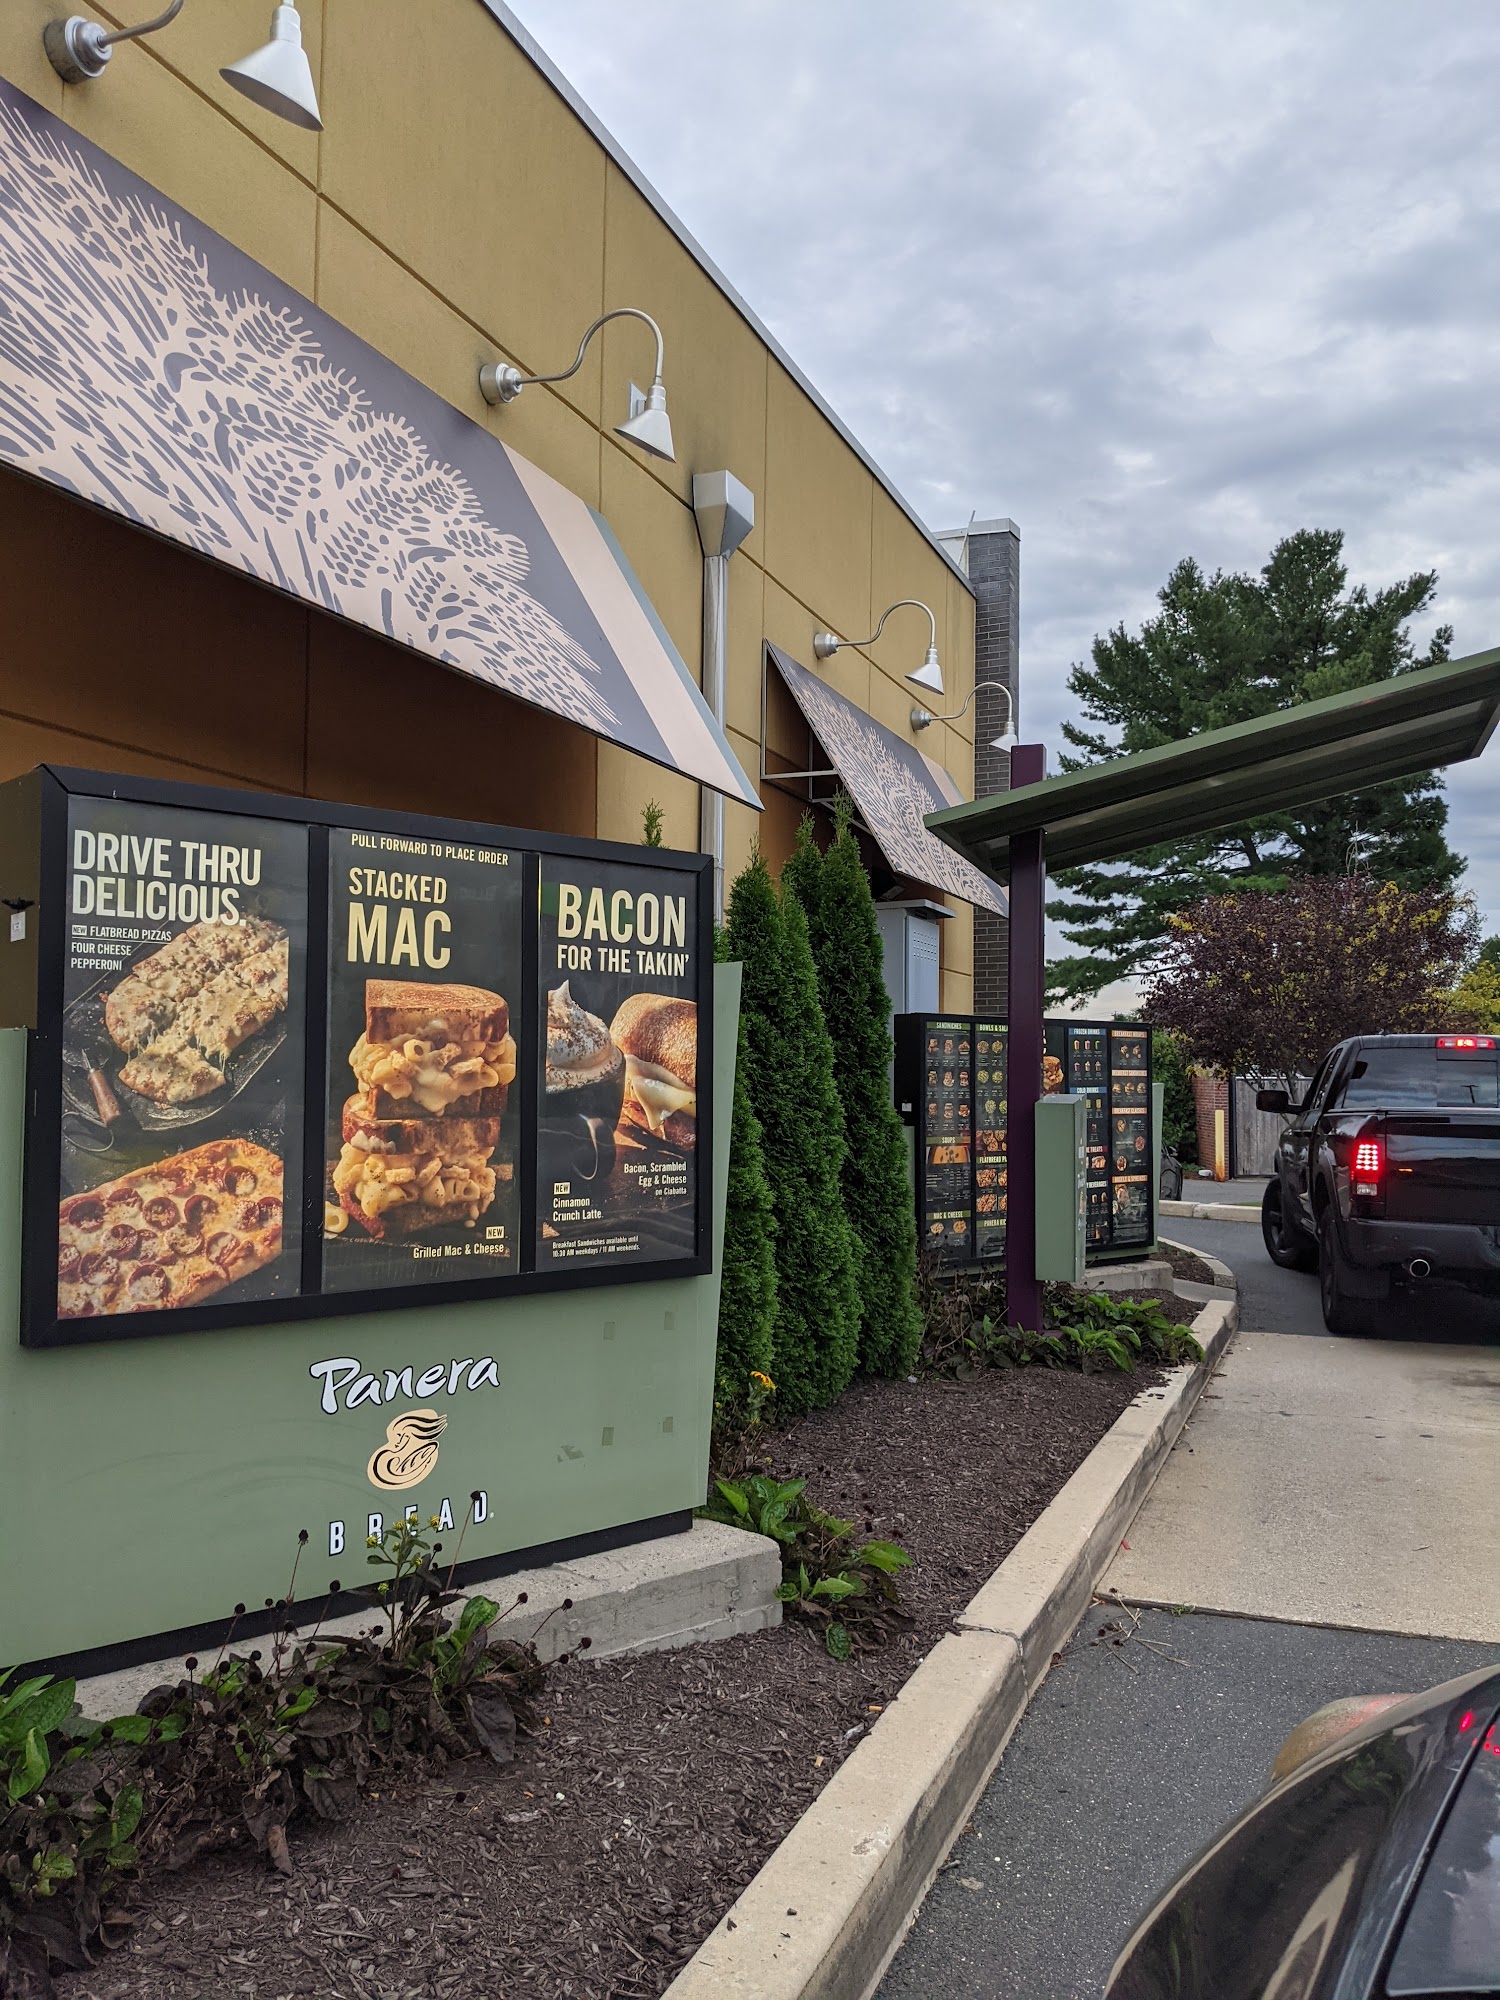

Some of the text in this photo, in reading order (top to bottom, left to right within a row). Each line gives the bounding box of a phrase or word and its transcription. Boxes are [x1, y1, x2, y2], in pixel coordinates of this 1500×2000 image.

[351, 833, 509, 866] PULL FORWARD TO PLACE ORDER
[73, 829, 261, 886] DRIVE THRU
[348, 867, 447, 904] STACKED
[72, 873, 246, 927] DELICIOUS.
[558, 883, 686, 948] BACON
[72, 925, 172, 941] NEW FLATBREAD PIZZAS
[347, 902, 452, 969] MAC
[71, 942, 132, 956] FOUR CHEESE
[71, 957, 122, 971] PEPPERONI
[557, 944, 592, 971] FOR
[597, 947, 632, 974] THE
[624, 1161, 687, 1174] Bacon, Scrambled
[638, 1174, 687, 1187] Egg & Cheese
[554, 1183, 570, 1194] NEW
[663, 1187, 687, 1195] Ciabatta
[553, 1198, 590, 1209] Cinnamon
[553, 1209, 580, 1222] Crunch
[487, 1227, 503, 1238] NEW
[413, 1243, 504, 1259] Grilled Mac & Cheese
[553, 1241, 576, 1249] Breakfast
[309, 1356, 500, 1415] Panera
